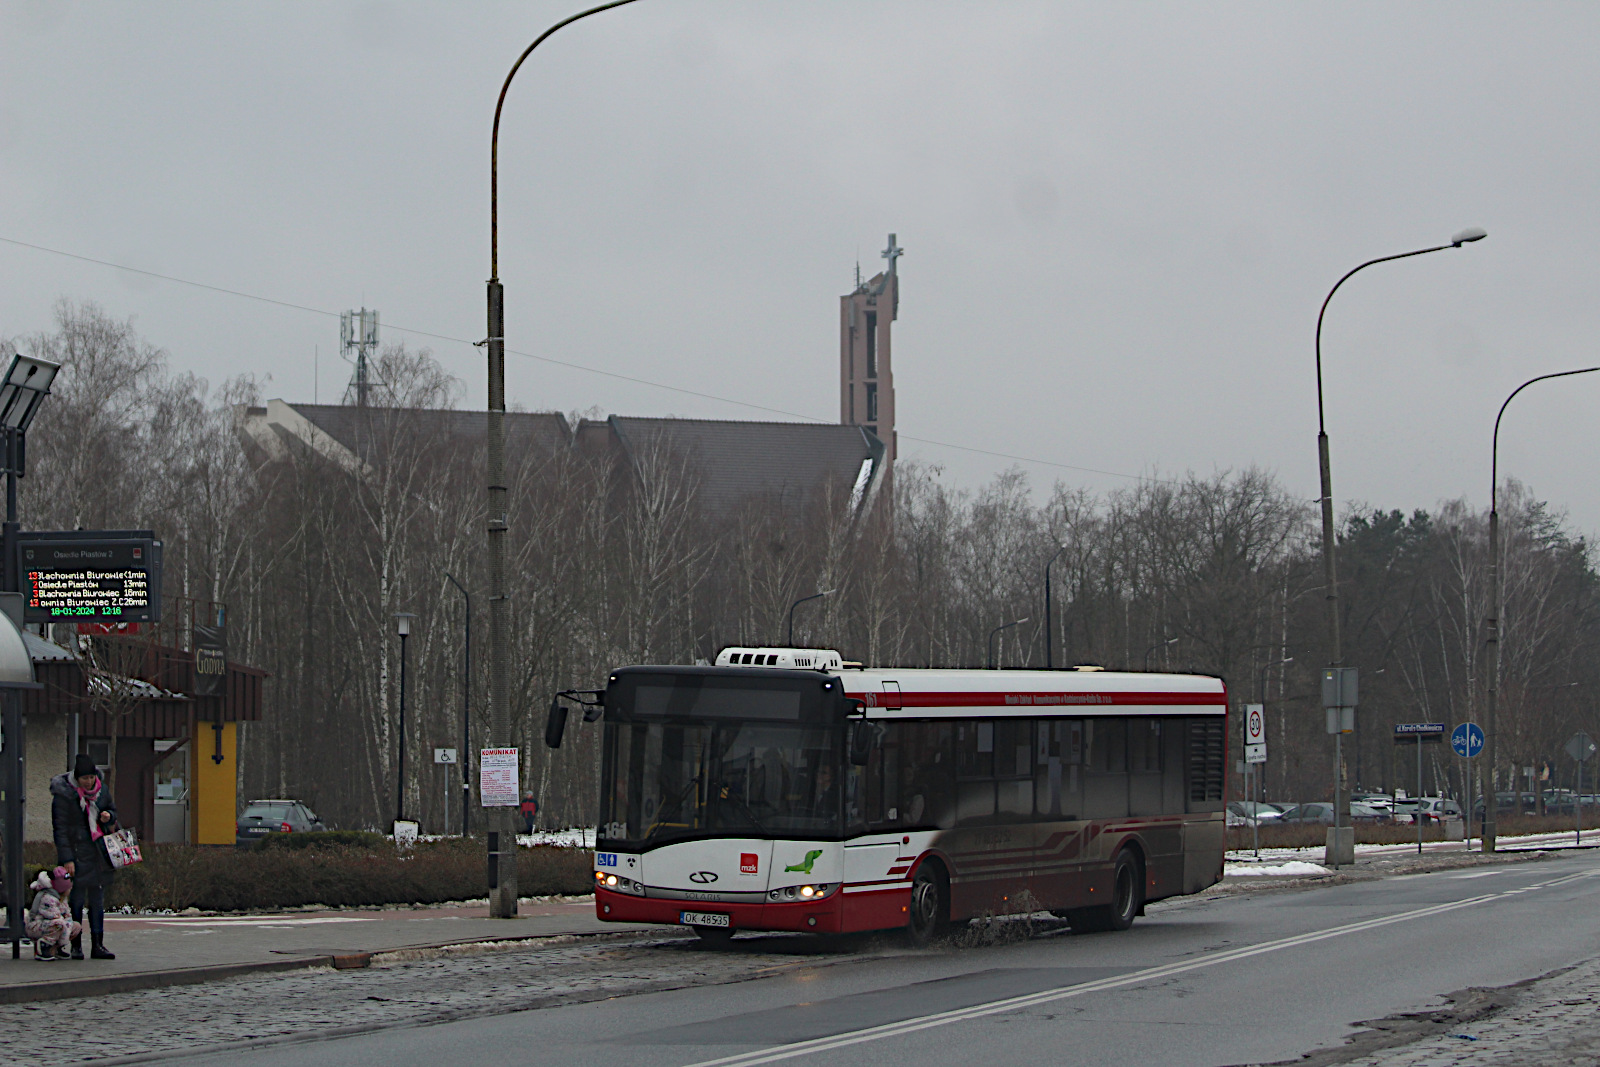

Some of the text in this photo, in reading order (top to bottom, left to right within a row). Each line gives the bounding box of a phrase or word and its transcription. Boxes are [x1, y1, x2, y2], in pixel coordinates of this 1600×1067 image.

[28, 571, 38, 580] 13
[32, 579, 147, 589] 2 Osiedle Piastów 13min
[32, 589, 39, 598] 3
[38, 589, 82, 598] Blachownia
[82, 588, 120, 598] Biurowiec
[29, 598, 40, 607] 13
[66, 598, 110, 607] Biurowiec
[50, 606, 122, 617] 18-01-2024 12:16
[865, 692, 878, 708] 161
[1251, 718, 1260, 730] 30
[603, 821, 627, 839] 161
[741, 864, 757, 872] mzk
[684, 892, 721, 901] SOLARIS
[685, 913, 728, 926] OK 48535
